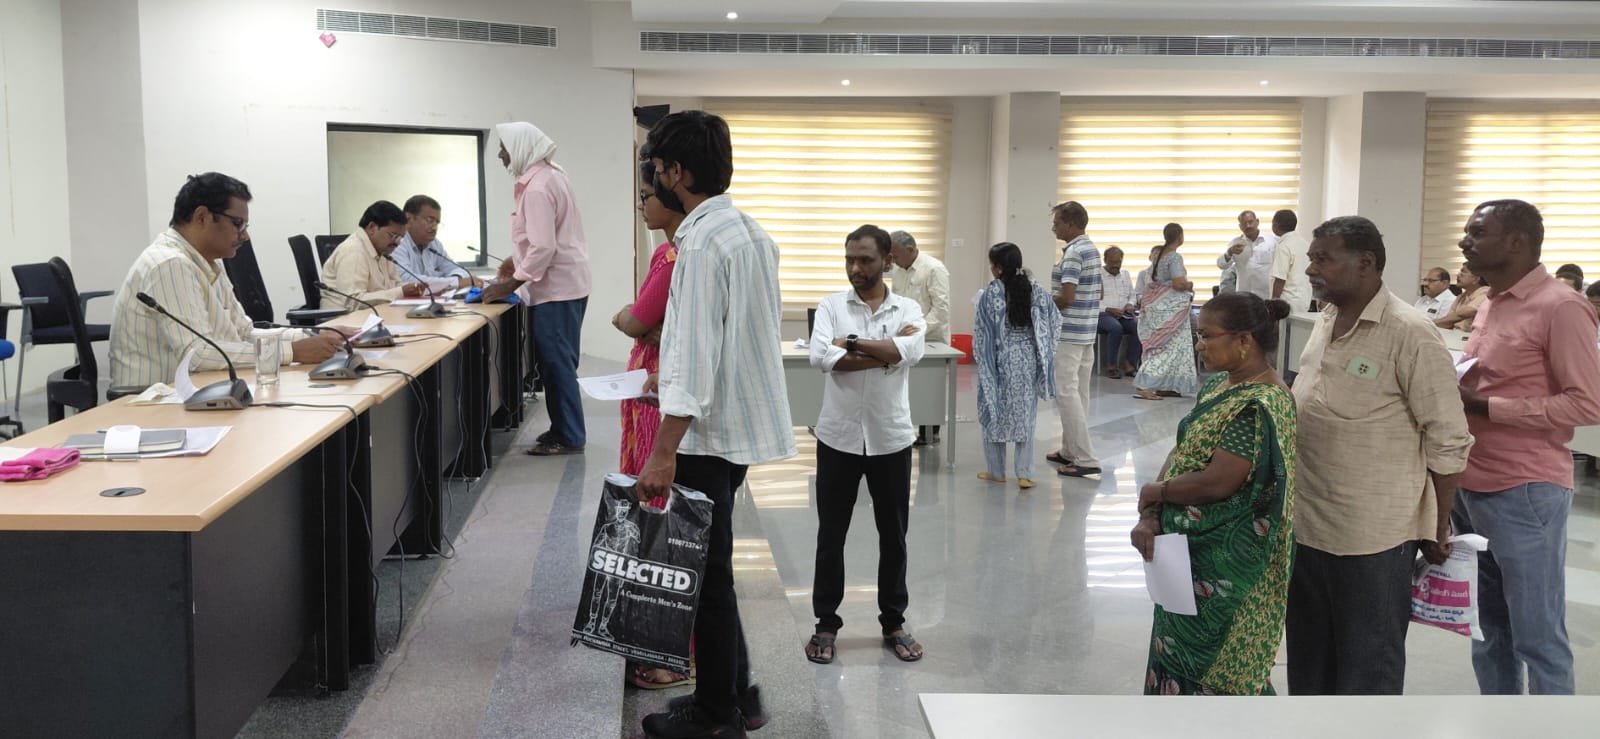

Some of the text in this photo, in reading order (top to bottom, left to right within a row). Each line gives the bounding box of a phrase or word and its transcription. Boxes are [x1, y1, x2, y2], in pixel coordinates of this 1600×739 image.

[591, 549, 691, 591] SELECTED
[620, 588, 625, 596] A
[658, 597, 676, 608] Men's
[676, 601, 693, 611] Zone
